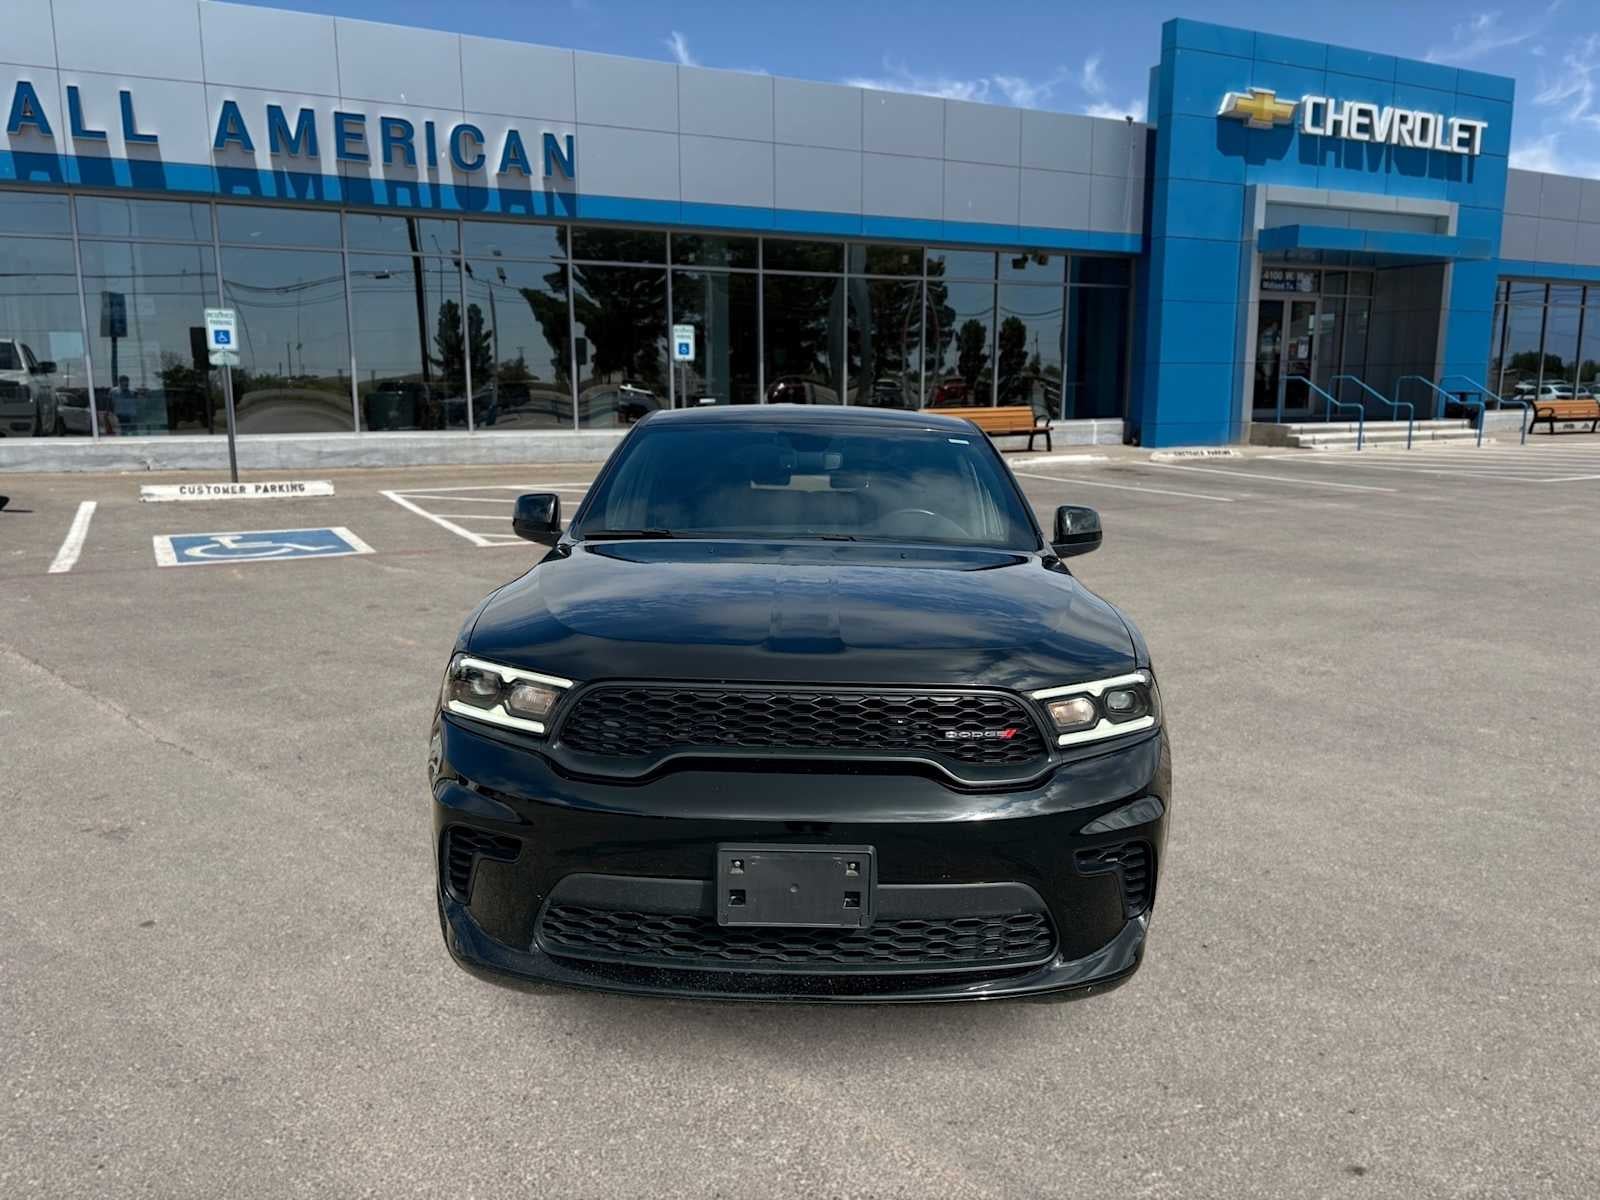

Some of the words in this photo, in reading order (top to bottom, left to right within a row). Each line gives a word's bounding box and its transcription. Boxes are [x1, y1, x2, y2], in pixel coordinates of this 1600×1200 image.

[7, 80, 159, 145] ALL
[213, 99, 576, 179] AMERICAN
[1301, 94, 1489, 156] CHEVROLET
[179, 485, 247, 496] CUSTOMER
[254, 483, 306, 494] PARKING
[945, 730, 1007, 739] DODGE
